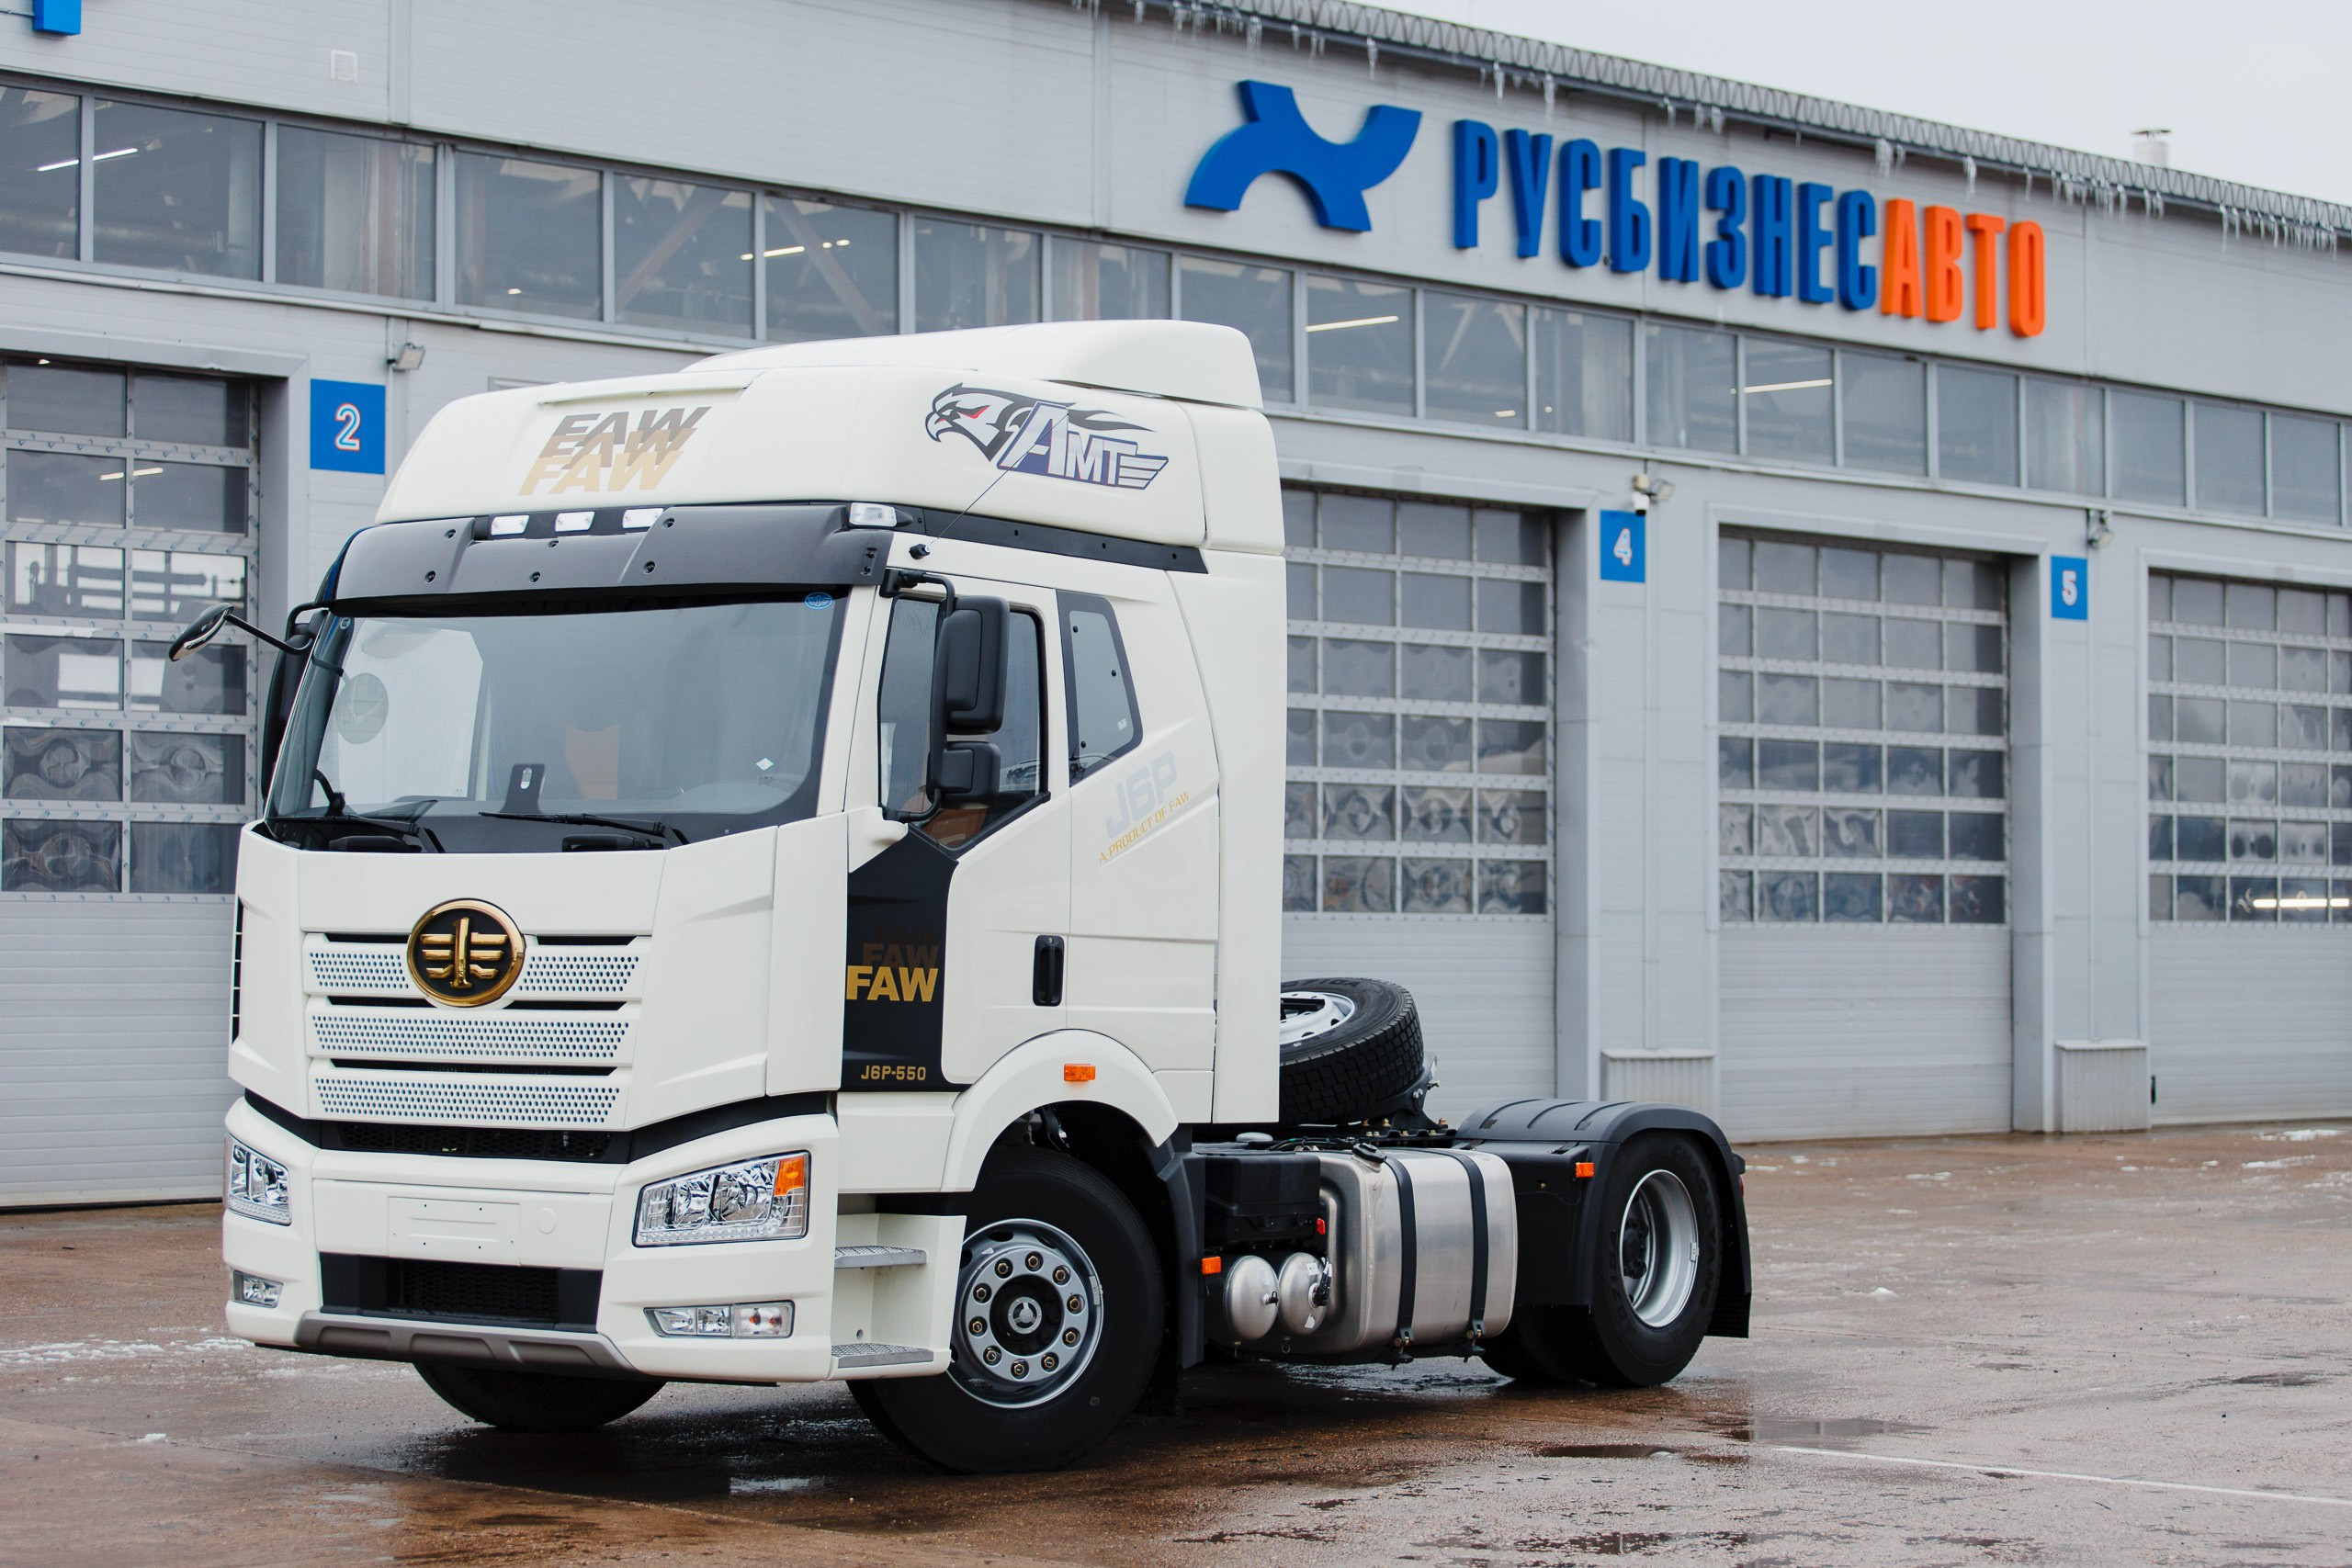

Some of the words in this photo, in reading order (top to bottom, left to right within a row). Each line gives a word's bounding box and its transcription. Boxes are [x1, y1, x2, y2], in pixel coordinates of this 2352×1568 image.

[1453, 119, 2045, 337] РУСБИЗНЕСАВТО
[335, 402, 361, 452] 2
[998, 400, 1138, 486] AMT
[518, 450, 684, 495] FAW
[1613, 527, 1632, 566] 4
[2062, 570, 2077, 606] 5
[1105, 750, 1177, 840] J6P
[1100, 852, 1108, 863] A
[1108, 816, 1153, 857] PRODUCT
[1155, 807, 1168, 824] OF
[1169, 789, 1190, 813] FAW
[863, 942, 939, 970] FAW
[845, 964, 939, 1002] FAW
[860, 1064, 927, 1081] J6P-550
